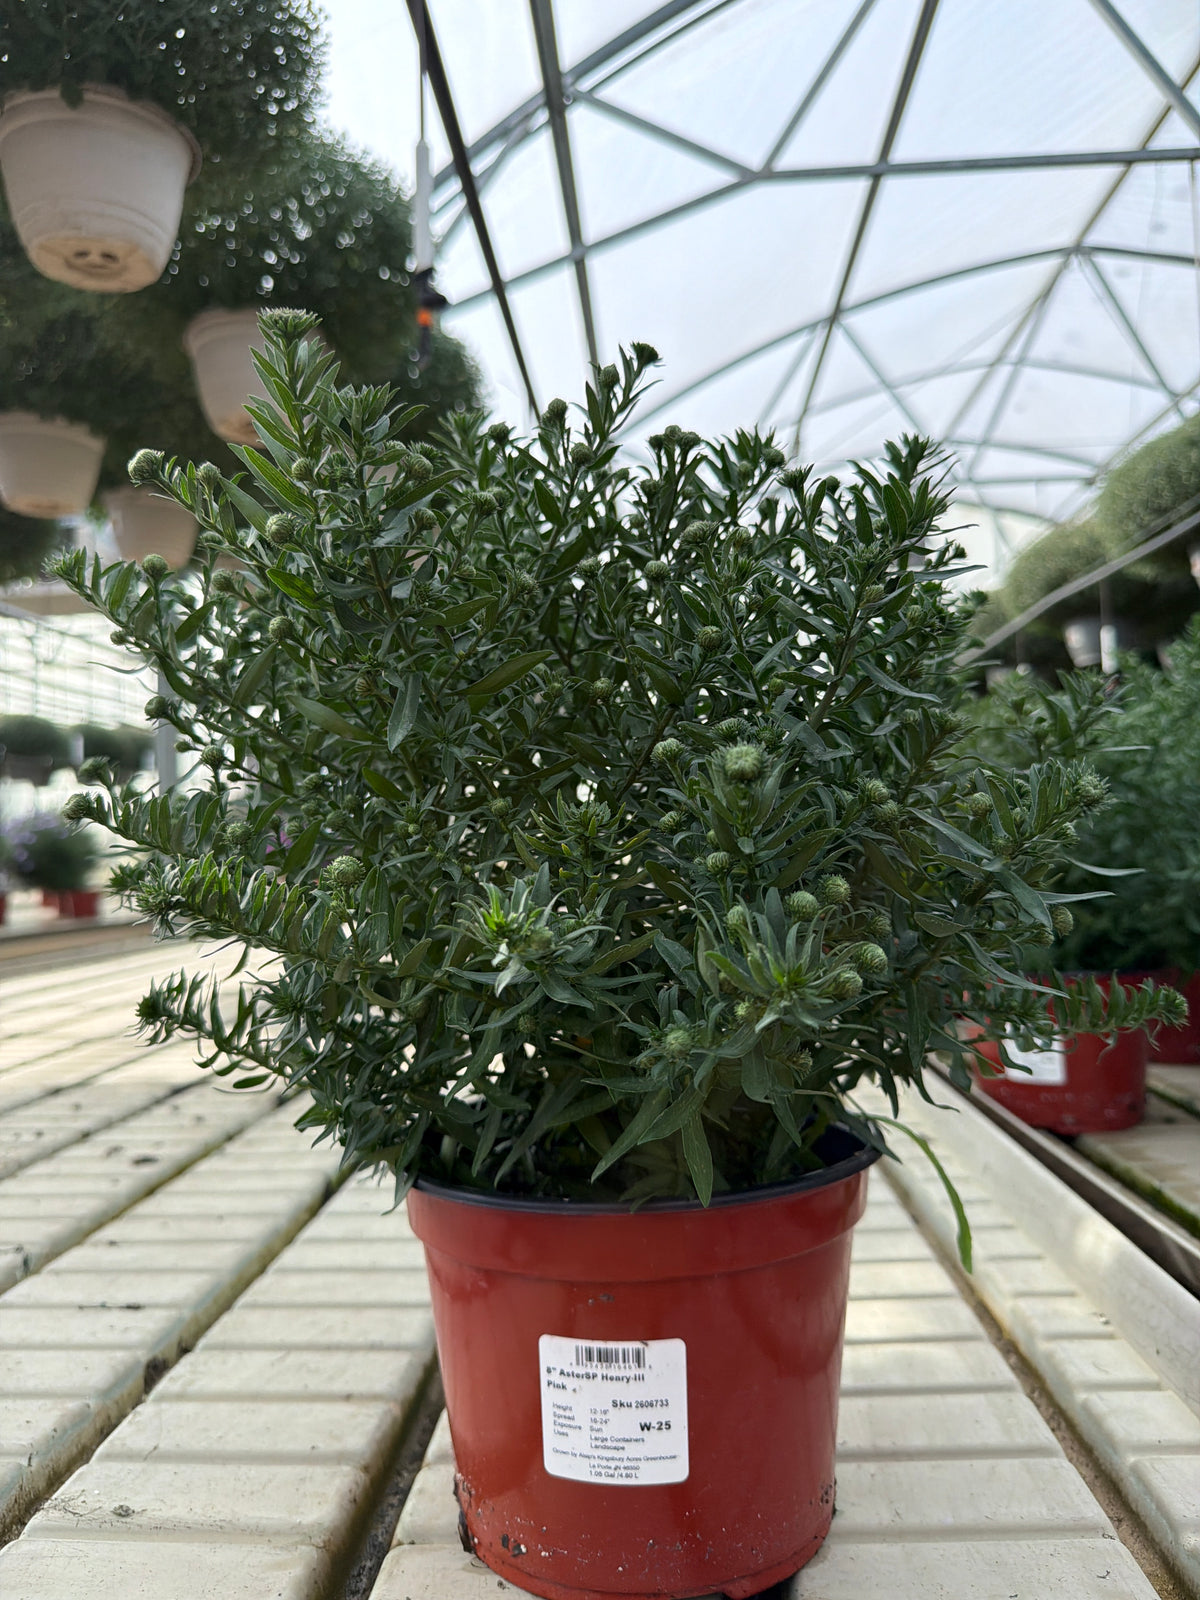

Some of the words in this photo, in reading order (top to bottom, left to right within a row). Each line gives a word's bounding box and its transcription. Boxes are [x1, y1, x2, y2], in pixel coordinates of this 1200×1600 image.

[559, 1369, 598, 1380] AsterSP
[601, 1373, 630, 1383] Henry
[547, 1380, 567, 1391] Pink
[553, 1402, 573, 1412] Height
[612, 1399, 632, 1408] Sku
[635, 1399, 669, 1408] 2606733
[553, 1411, 575, 1421] Spread
[553, 1420, 582, 1430] Exposure
[590, 1425, 603, 1433] Sun
[639, 1421, 671, 1431] W-25
[553, 1429, 569, 1437] Uses
[590, 1435, 608, 1443] Large
[590, 1443, 625, 1451] Landscape
